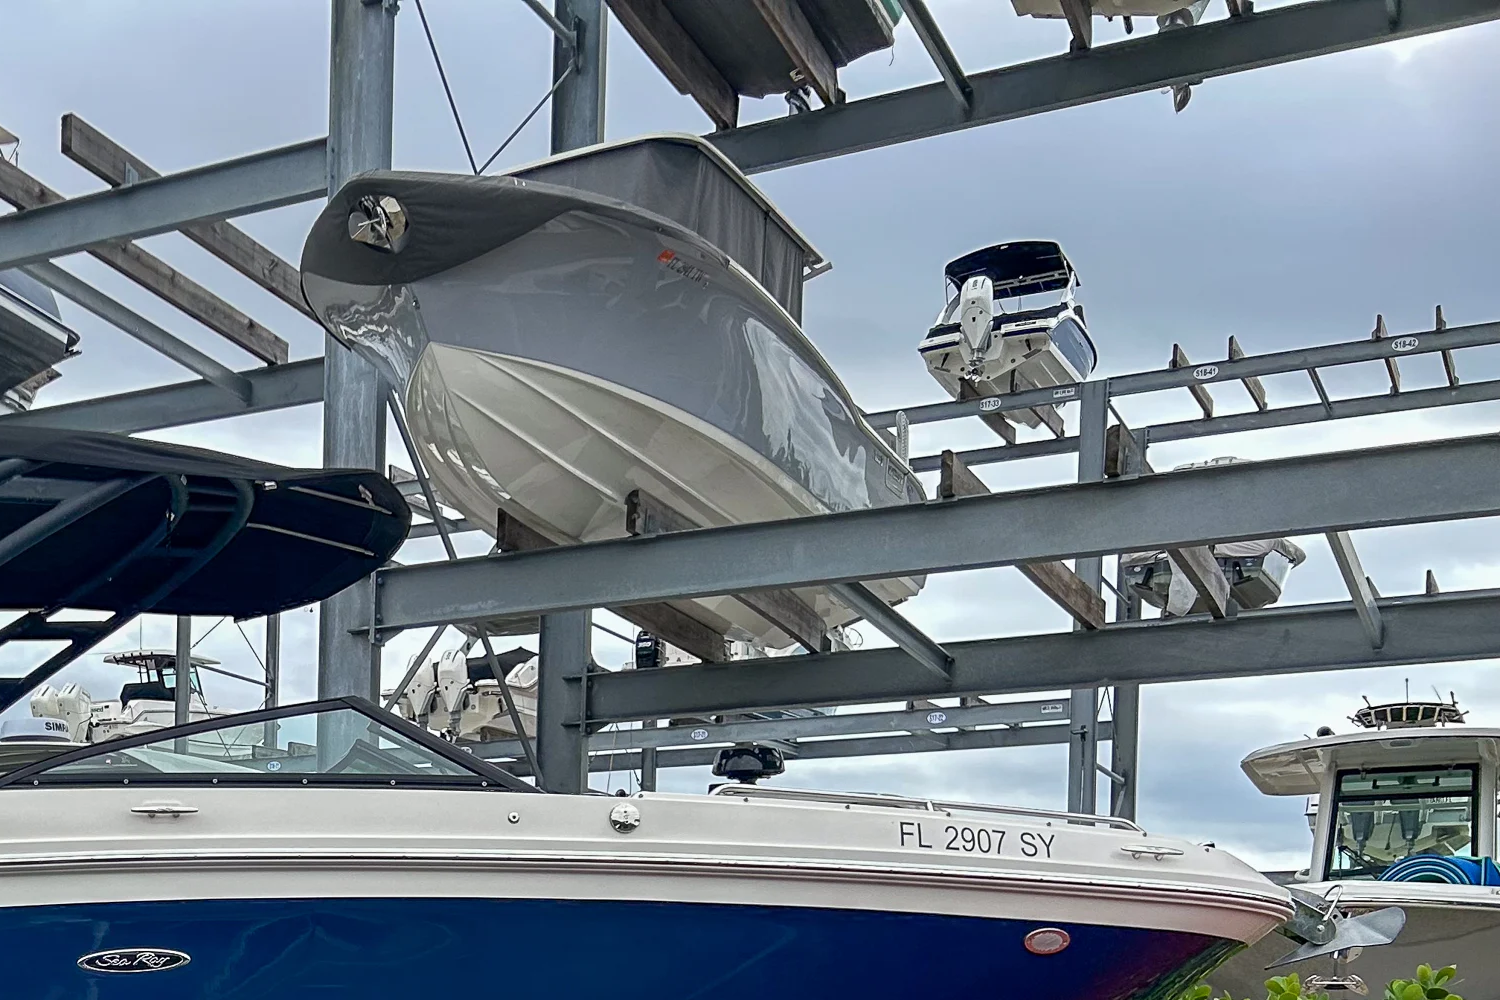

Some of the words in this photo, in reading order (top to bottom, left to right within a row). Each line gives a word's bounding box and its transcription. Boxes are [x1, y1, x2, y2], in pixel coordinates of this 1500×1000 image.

[1393, 338, 1417, 349] S18-42
[899, 821, 933, 849] FL
[944, 825, 1006, 854] 2907
[1020, 832, 1055, 858] SY
[95, 954, 132, 967] Sea
[132, 951, 171, 968] Ray
